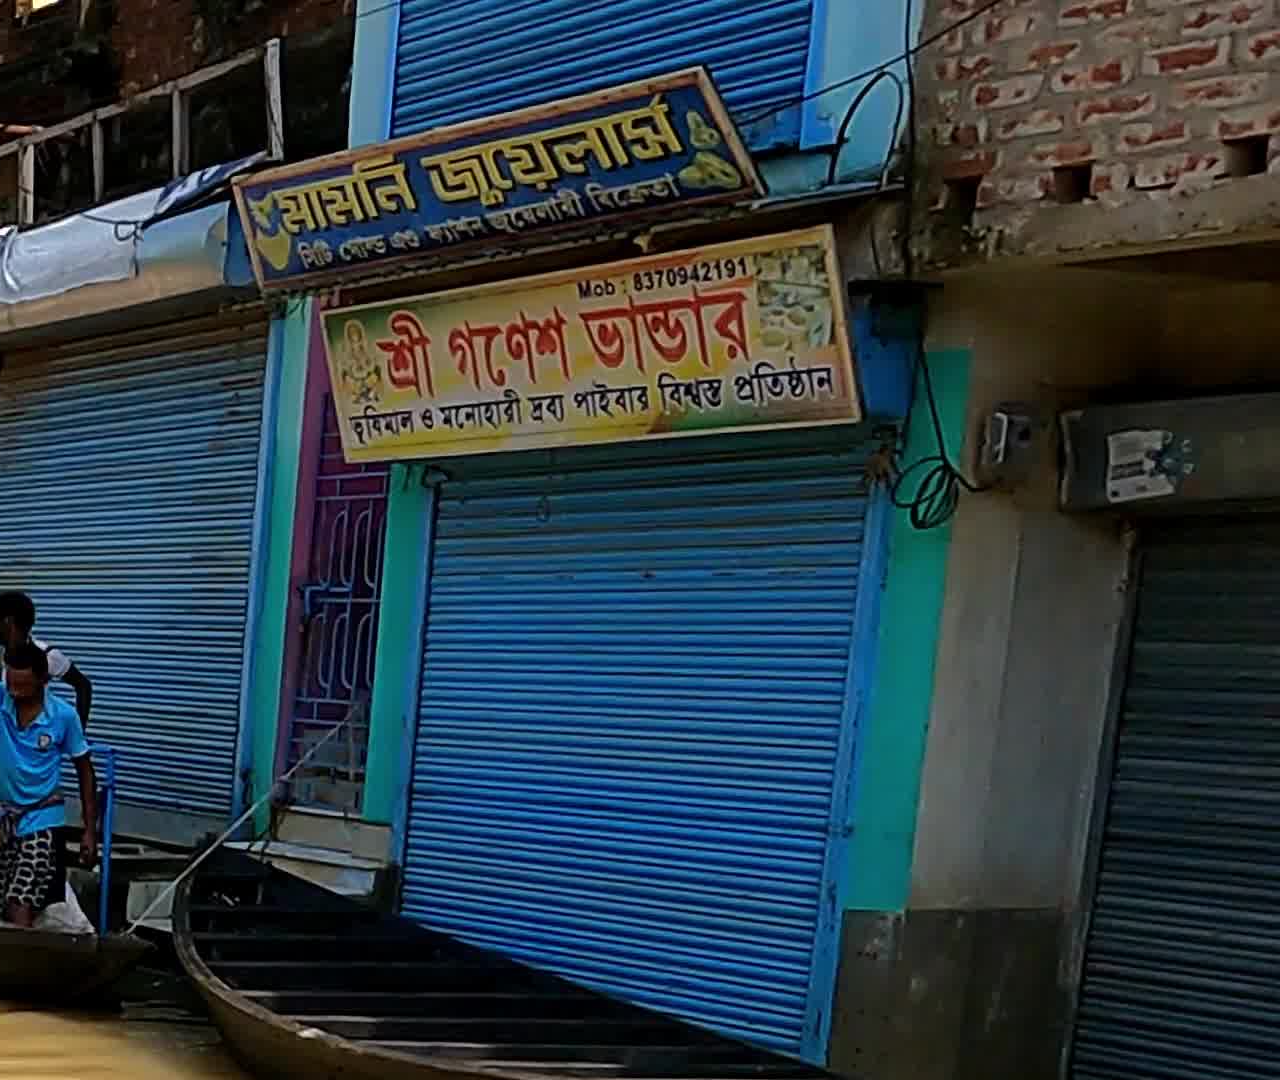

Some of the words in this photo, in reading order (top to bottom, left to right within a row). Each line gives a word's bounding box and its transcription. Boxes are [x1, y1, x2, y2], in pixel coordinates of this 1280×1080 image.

[421, 93, 683, 207] জুয়েলার্স
[577, 280, 615, 300] Mob
[632, 257, 748, 293] 8370942191
[376, 310, 436, 399] শ্রী
[447, 305, 571, 390] গণেশ
[421, 409, 434, 430] ও
[437, 389, 522, 430] মনোহারী
[527, 394, 564, 423] দ্রব্য
[574, 377, 649, 418] পাইবার
[657, 370, 723, 415] বিশ্বস্ত
[733, 355, 833, 402] প্রতিষ্ঠান
